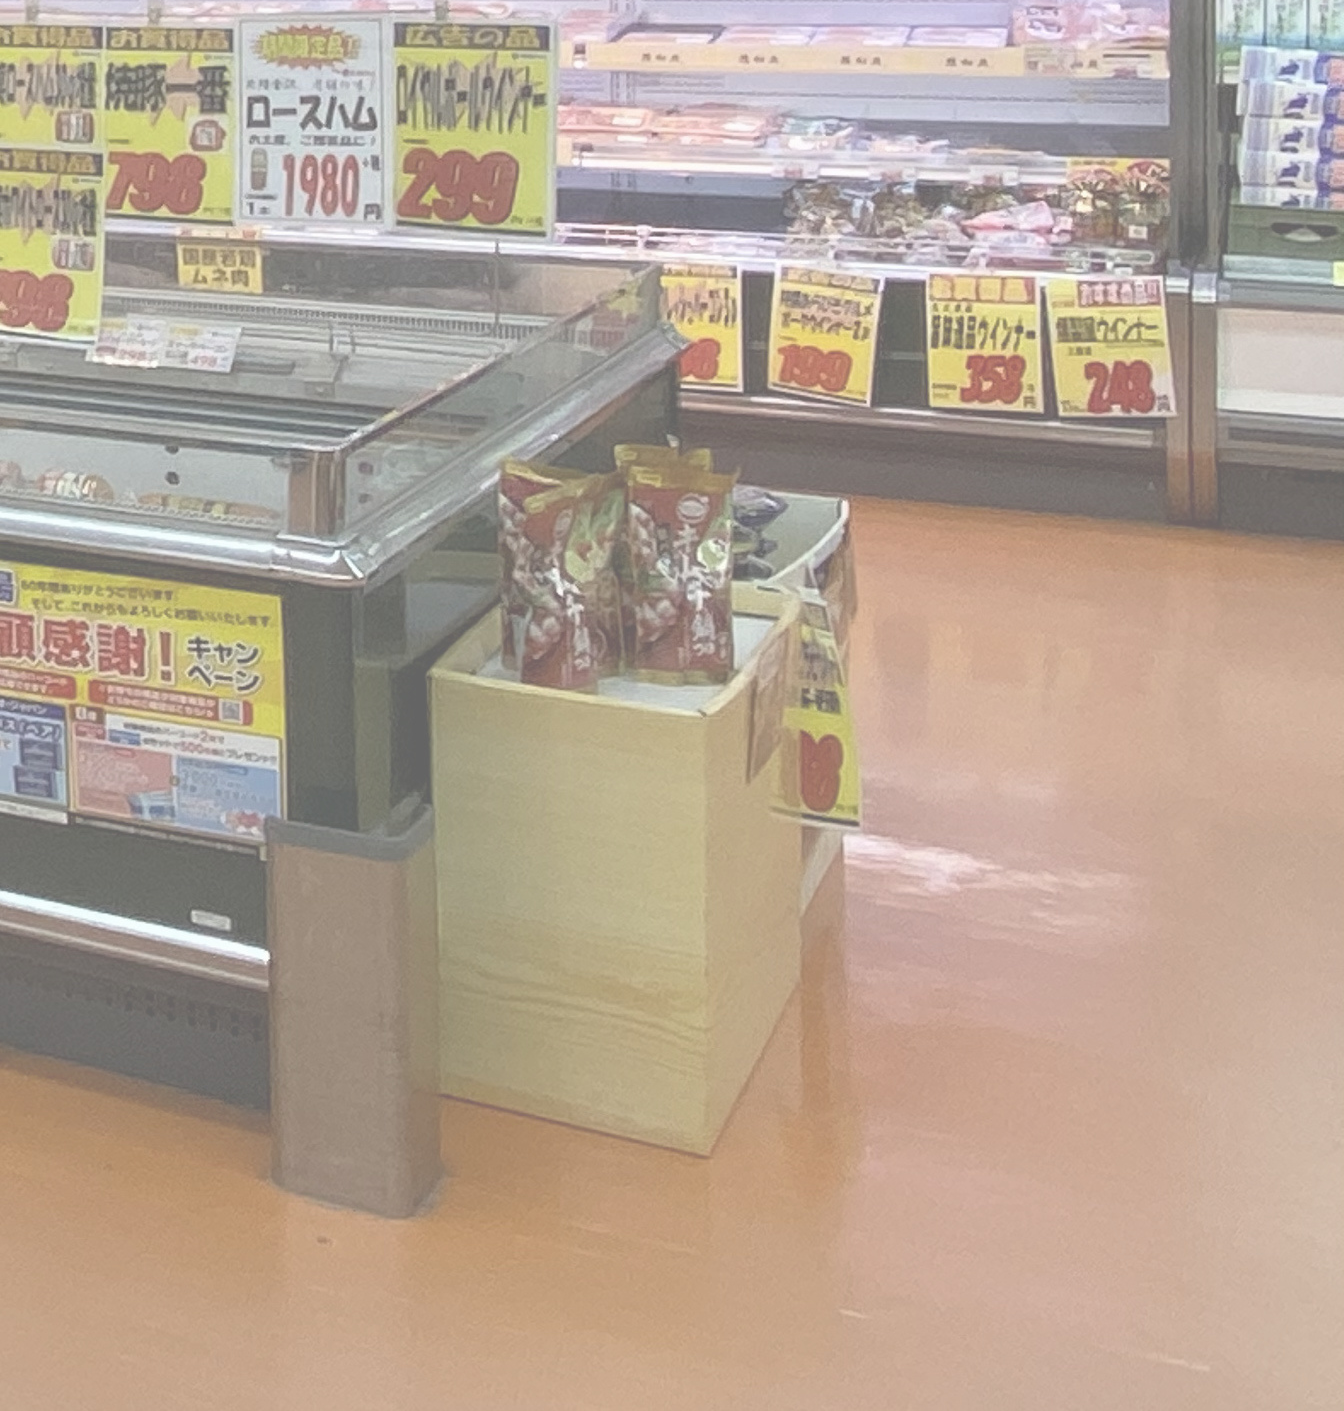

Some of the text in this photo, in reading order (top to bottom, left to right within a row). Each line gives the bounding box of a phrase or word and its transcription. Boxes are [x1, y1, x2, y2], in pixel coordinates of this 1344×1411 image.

[406, 26, 541, 49] 広告の品
[246, 95, 378, 131] ロースハム
[108, 151, 208, 215] 798
[282, 153, 360, 218] 1980
[397, 147, 520, 226] 299
[187, 635, 259, 665] キャン
[187, 663, 260, 692] ペーン
